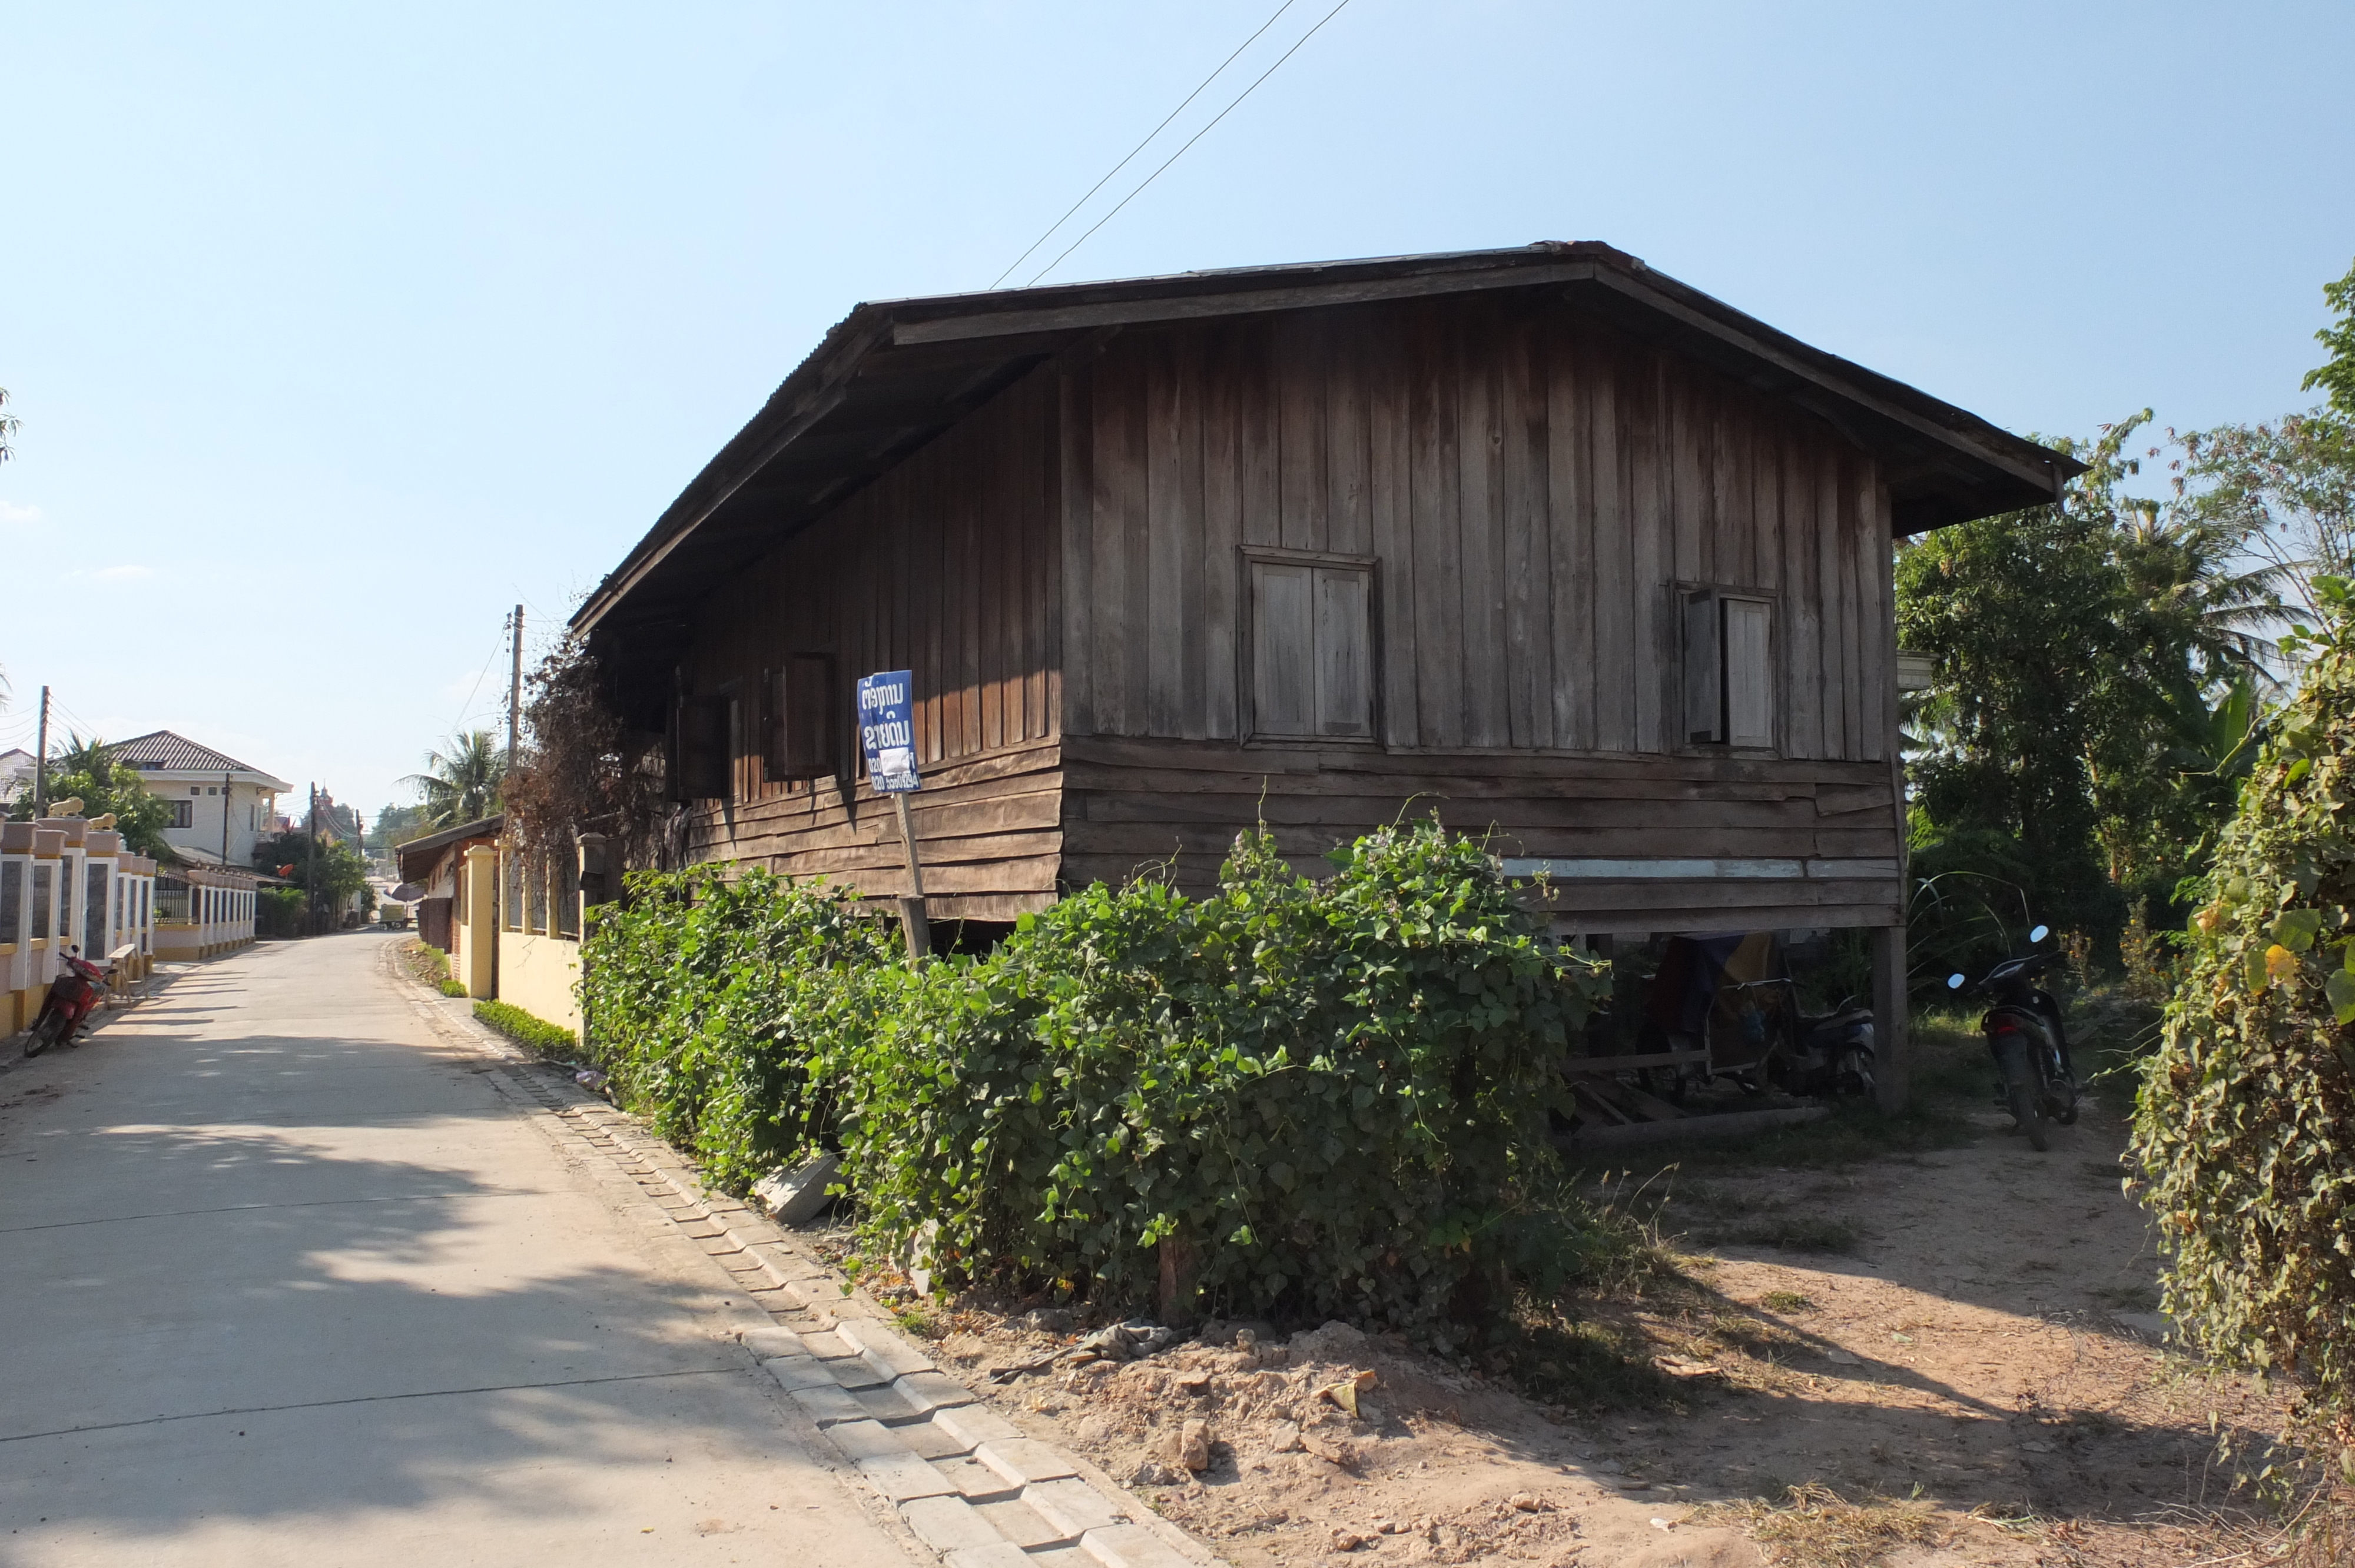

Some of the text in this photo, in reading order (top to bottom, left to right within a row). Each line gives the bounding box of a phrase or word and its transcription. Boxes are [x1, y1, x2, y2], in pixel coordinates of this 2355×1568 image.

[864, 710, 910, 749] ຂາຍດິນ
[868, 758, 882, 773] 020
[871, 775, 885, 790] 020
